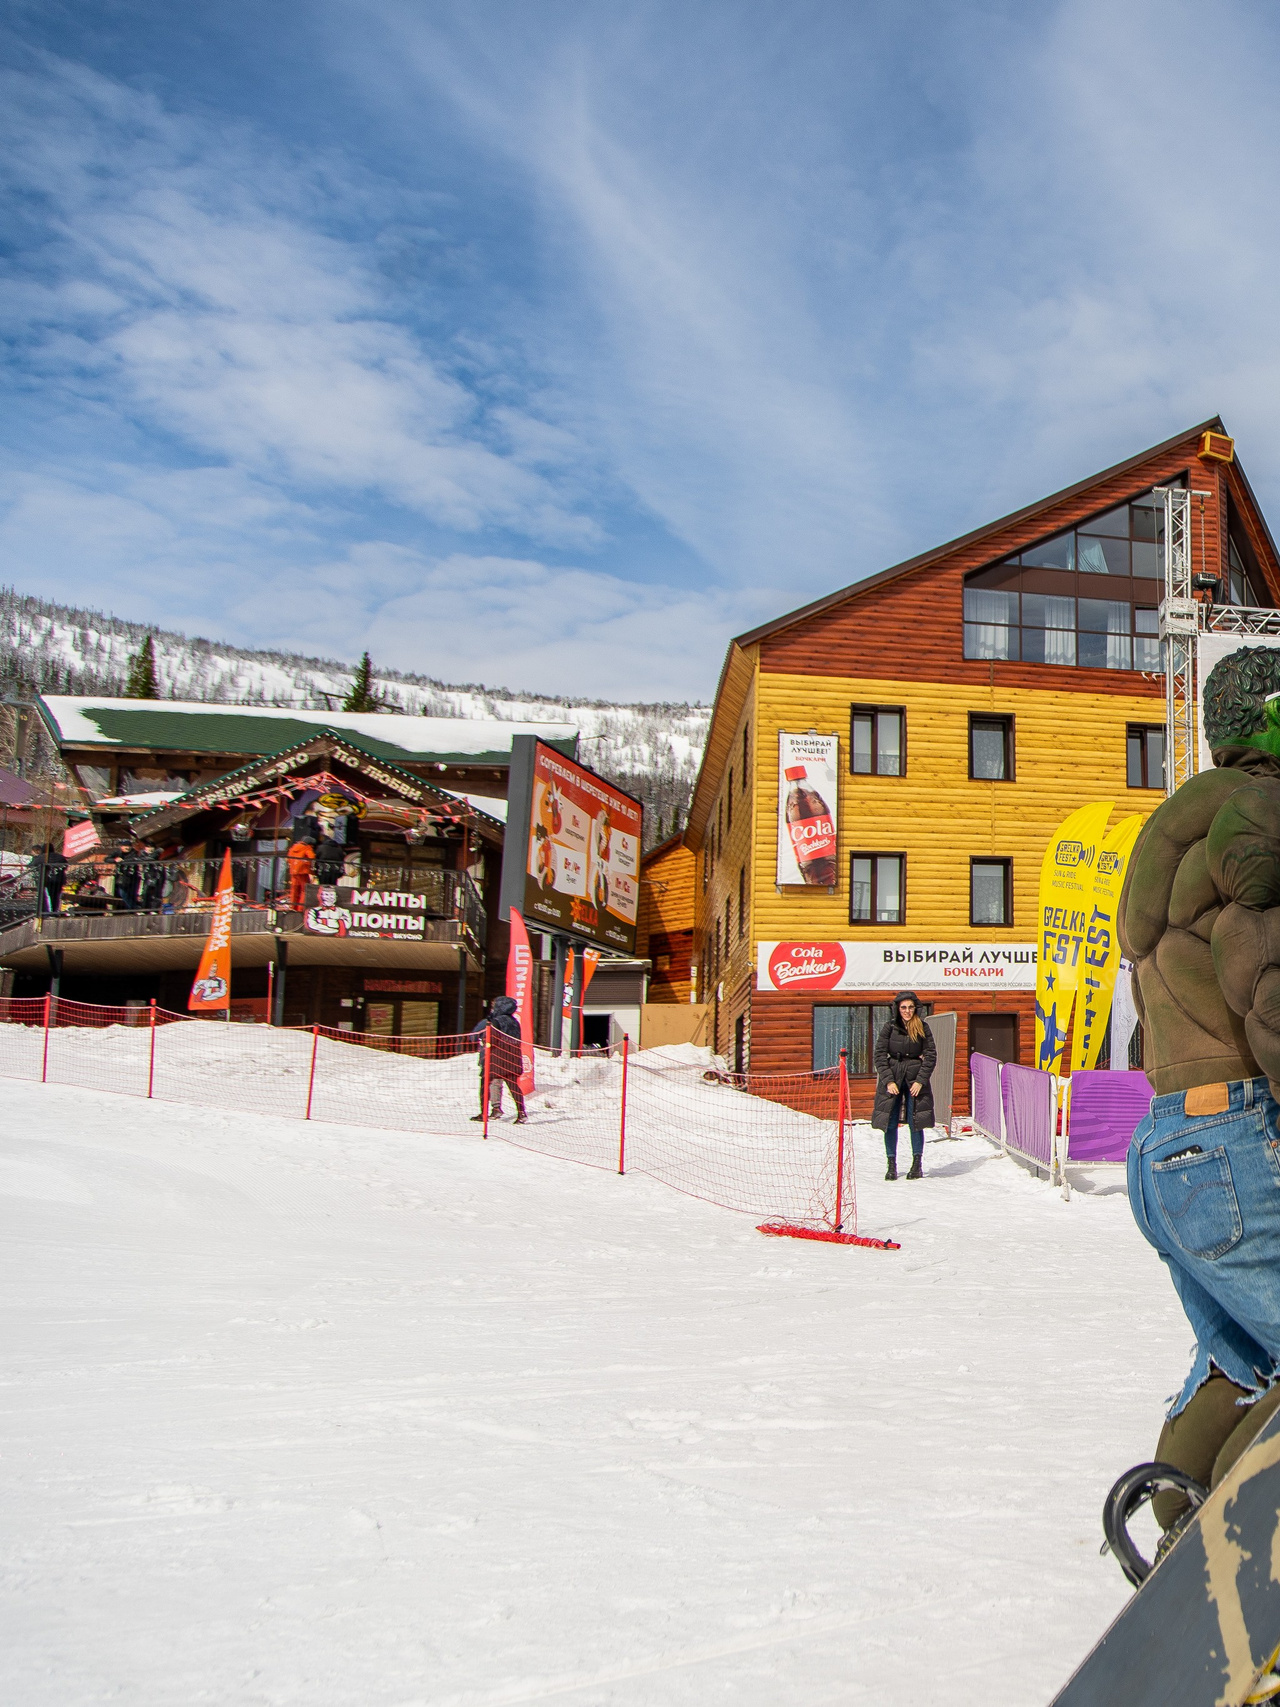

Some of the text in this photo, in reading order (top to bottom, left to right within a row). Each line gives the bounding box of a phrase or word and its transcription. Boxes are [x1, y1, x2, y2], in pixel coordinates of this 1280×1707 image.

[790, 738, 832, 748] ВЫБИРАЙ
[332, 746, 360, 769] ПО
[795, 755, 827, 763] БОЧКАРИ
[791, 819, 833, 843] Cola
[351, 889, 427, 910] МАНТЫ
[351, 911, 425, 931] ПОНТЫ
[791, 946, 823, 958] Cola
[883, 947, 1037, 964] ВЫБИРАЙ ЛУЧШЕ
[1043, 930, 1084, 967] FST
[773, 959, 841, 982] Bochkari
[943, 967, 1004, 977] БОЧКАРИ
